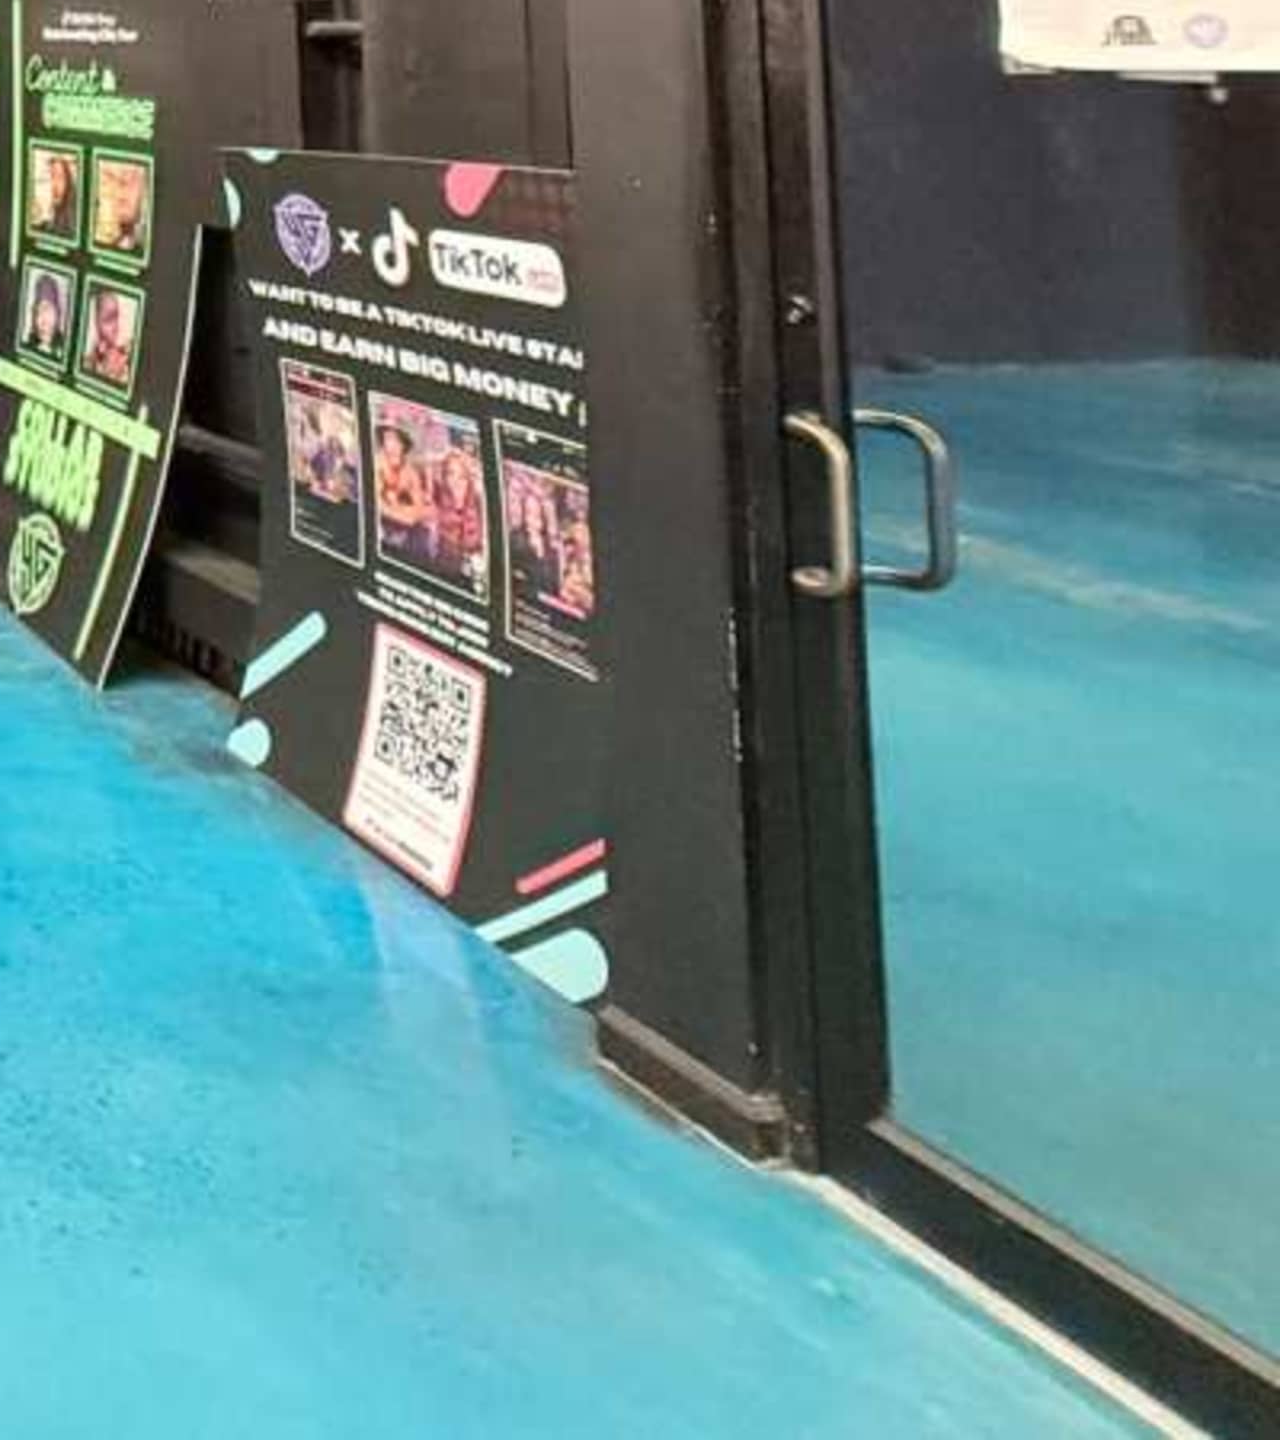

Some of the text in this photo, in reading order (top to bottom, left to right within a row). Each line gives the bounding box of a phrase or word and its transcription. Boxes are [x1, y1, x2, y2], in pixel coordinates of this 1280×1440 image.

[25, 53, 102, 93] Content
[433, 241, 523, 287] TikTok
[248, 278, 307, 307] WANT
[383, 306, 468, 344] TIKTOK
[466, 325, 525, 355] LIVE
[261, 316, 318, 348] AND
[319, 328, 396, 370] EARN
[398, 347, 452, 383] BIG
[452, 362, 575, 417] MONEY
